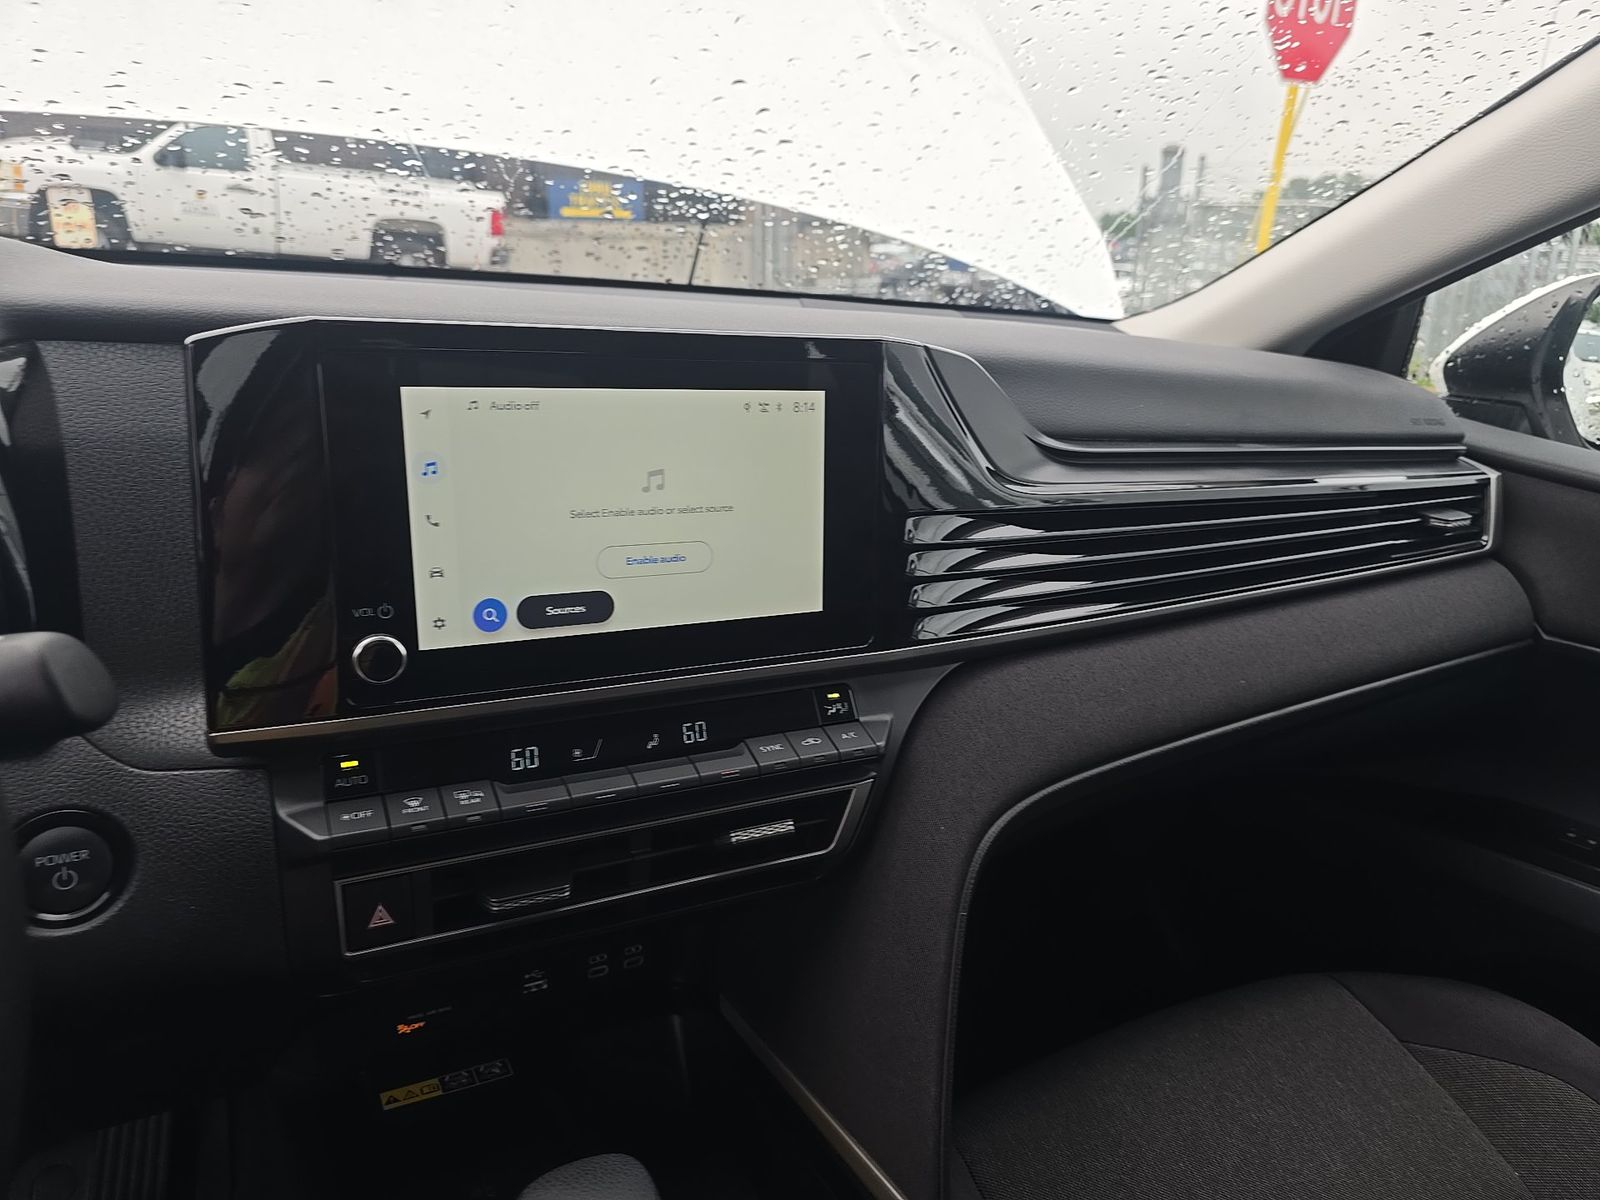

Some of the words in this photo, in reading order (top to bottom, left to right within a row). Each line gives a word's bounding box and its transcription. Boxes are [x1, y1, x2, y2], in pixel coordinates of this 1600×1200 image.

[489, 400, 522, 411] Audio
[524, 400, 541, 411] off
[793, 401, 815, 413] 8:14
[569, 509, 600, 519] Select
[601, 507, 635, 517] Enable
[637, 504, 664, 516] audio
[665, 506, 676, 516] or
[677, 504, 704, 514] select
[705, 504, 735, 514] source
[626, 555, 658, 566] Enable
[659, 553, 687, 564] audio
[351, 607, 376, 618] VOL
[545, 606, 587, 616] Sources
[682, 720, 708, 744] 60
[759, 743, 785, 754] SYNC
[510, 746, 540, 771] 60
[335, 774, 369, 788] AUTO
[350, 809, 375, 820] OFF
[34, 849, 90, 867] POWER
